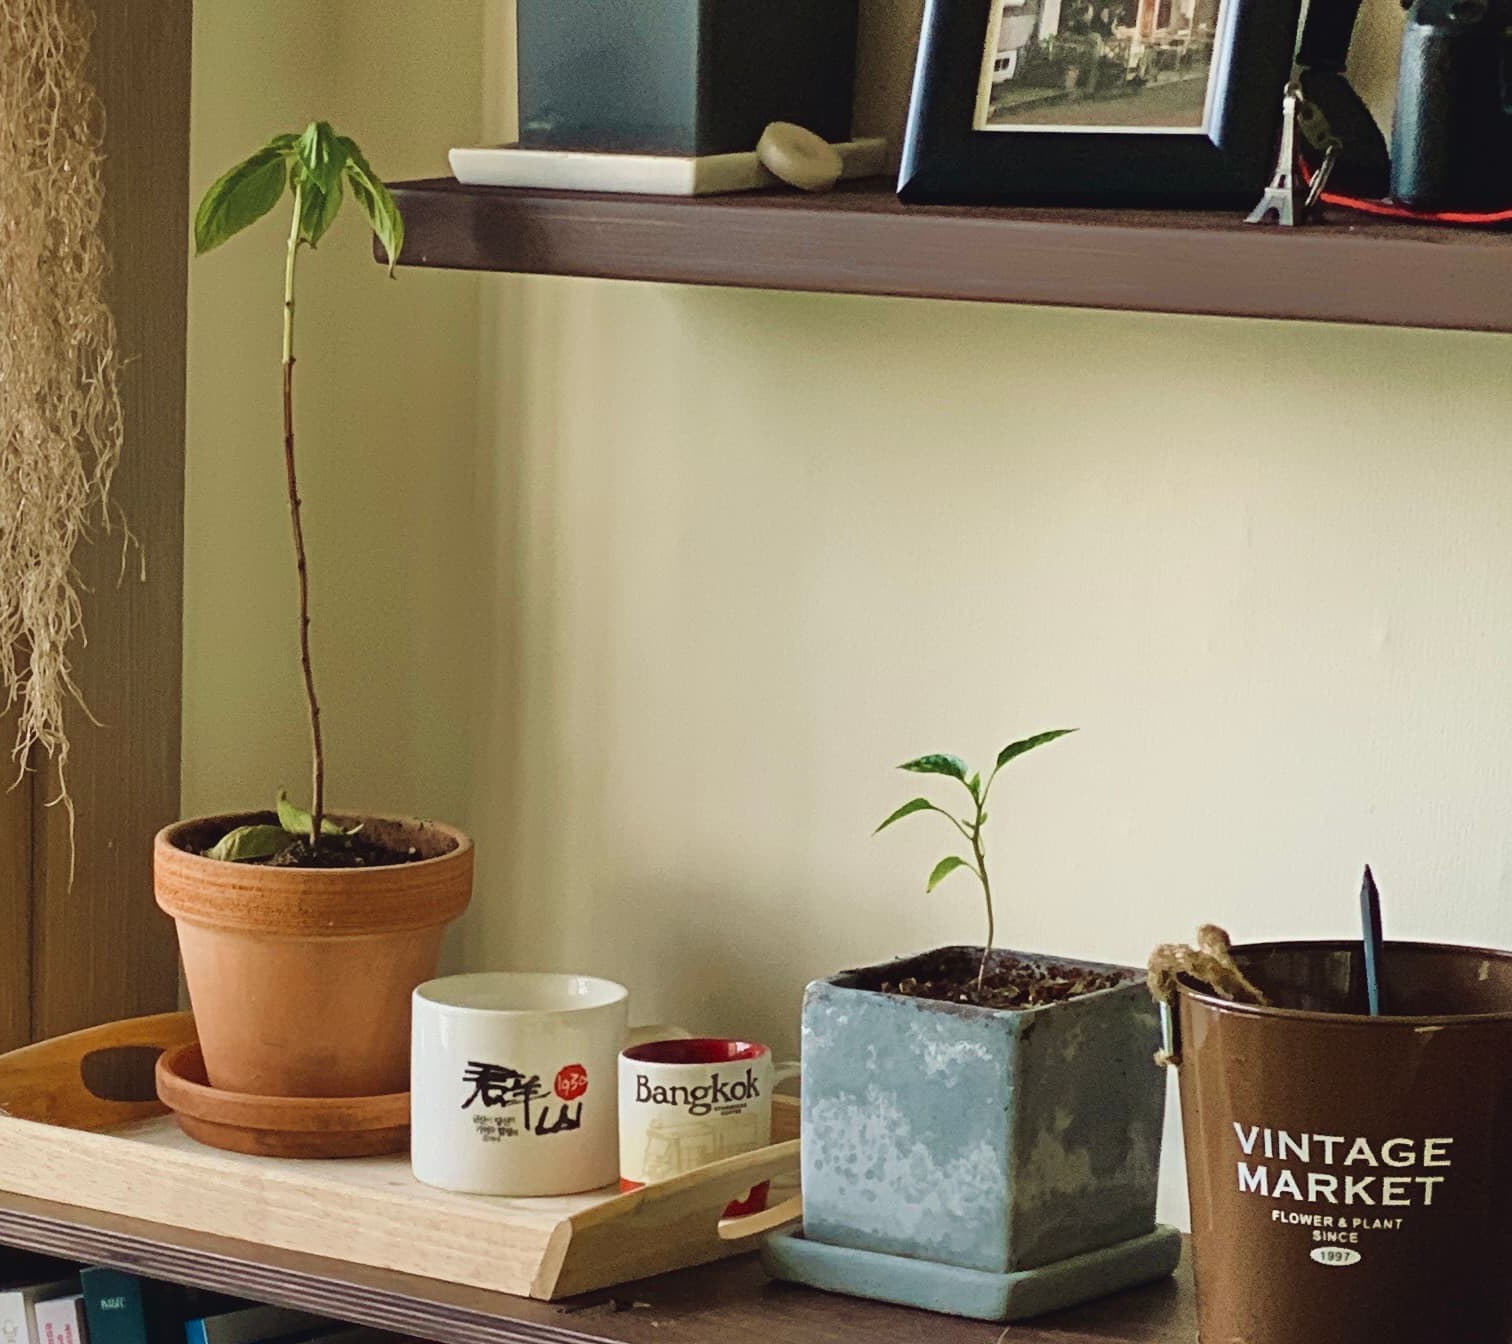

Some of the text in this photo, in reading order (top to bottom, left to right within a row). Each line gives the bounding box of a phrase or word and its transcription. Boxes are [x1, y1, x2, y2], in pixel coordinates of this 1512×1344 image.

[636, 1068, 760, 1116] Bangkok
[1233, 1121, 1453, 1167] VINTAGE
[1238, 1161, 1445, 1206] MARKET
[1272, 1209, 1404, 1230] FLOWER & PLANT
[1312, 1229, 1359, 1244] SINCE
[1320, 1250, 1351, 1264] 1997
